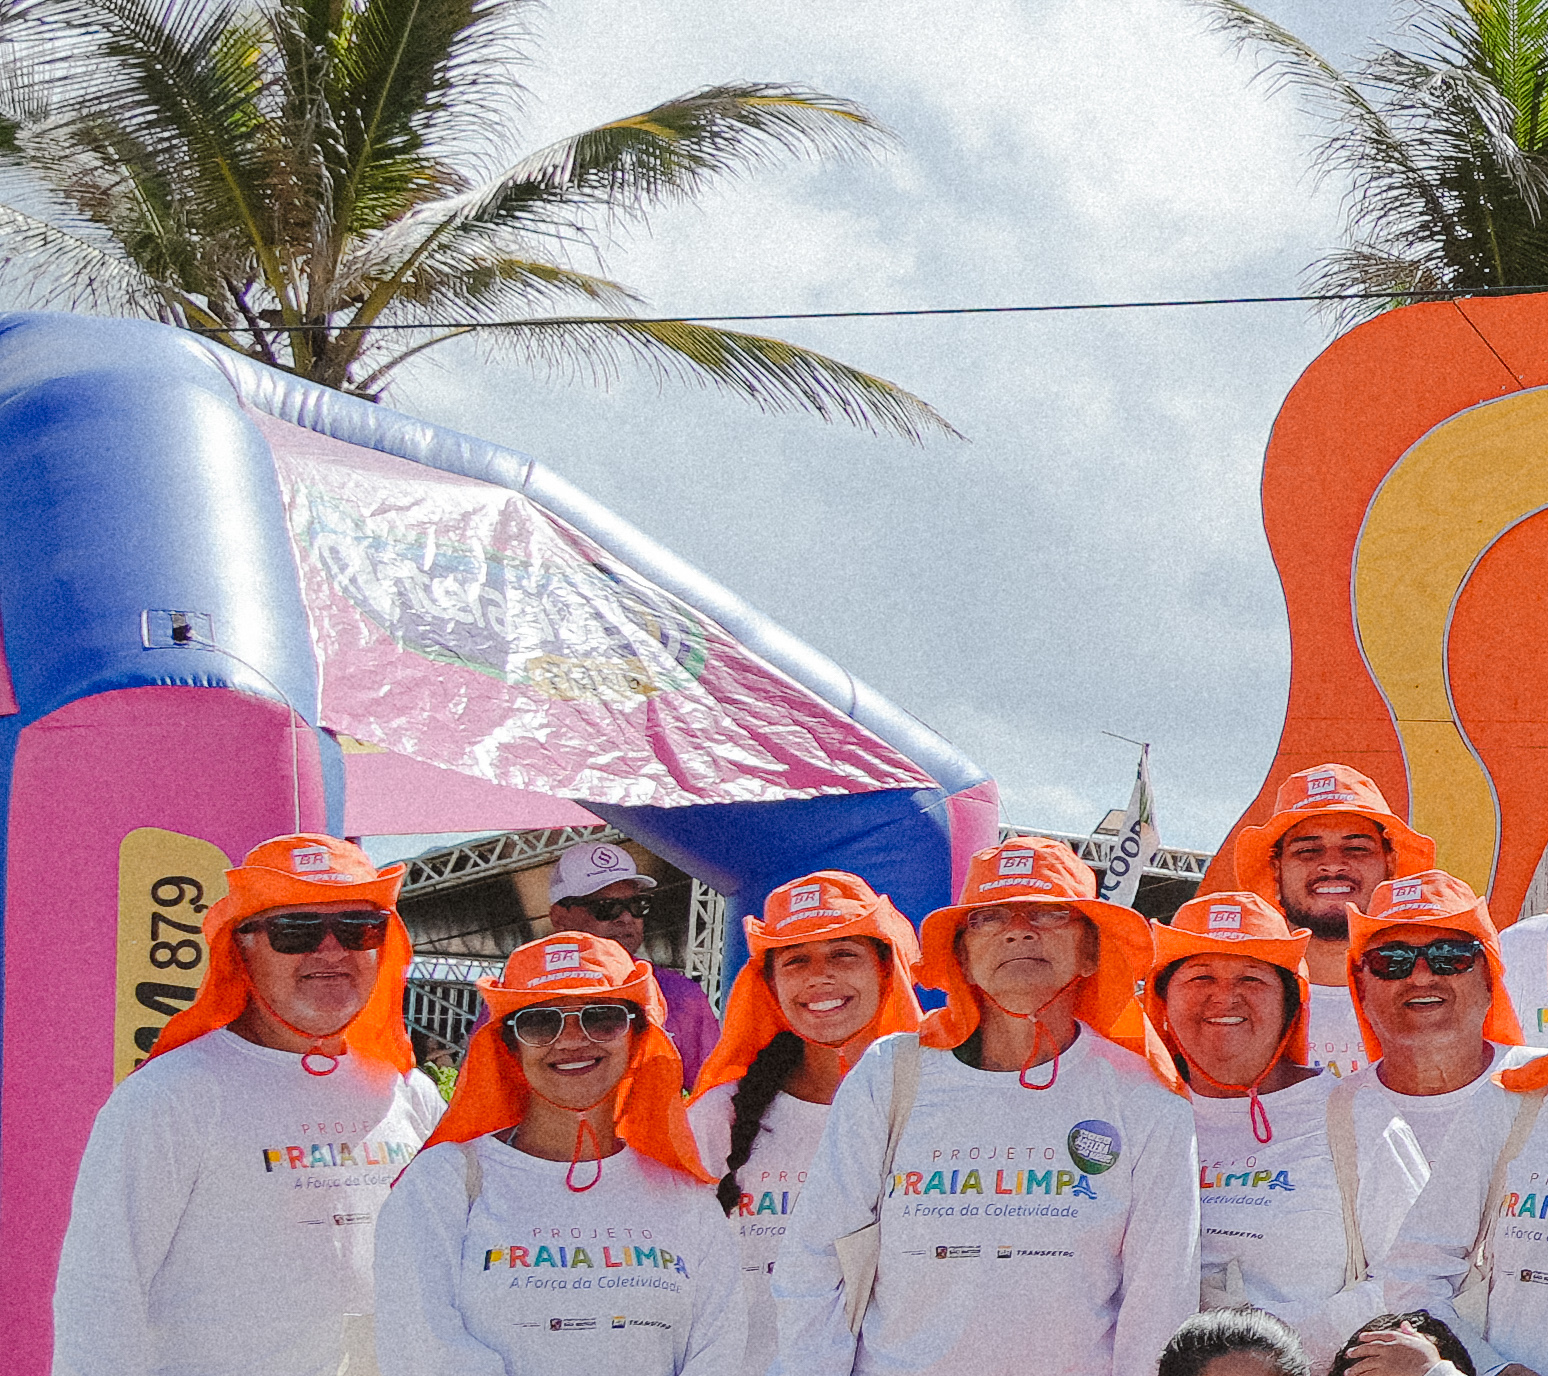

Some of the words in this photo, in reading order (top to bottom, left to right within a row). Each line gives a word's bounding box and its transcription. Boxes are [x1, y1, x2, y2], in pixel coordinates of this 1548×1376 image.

[978, 878, 1052, 891] TRANSPETRO
[932, 1146, 1056, 1163] PROJETO
[995, 1169, 1098, 1200] LIMPA
[1201, 1166, 1295, 1193] LIMPA
[916, 1204, 956, 1220] Força
[961, 1204, 979, 1217] da
[985, 1203, 1079, 1219] Coletividade
[533, 1226, 653, 1241] PROJETO
[1511, 1226, 1543, 1244] Força
[484, 1245, 593, 1271] PRAIA
[603, 1245, 691, 1279] LIMPA
[526, 1275, 567, 1292] Força
[573, 1275, 592, 1289] da
[598, 1275, 682, 1294] Coletividade
